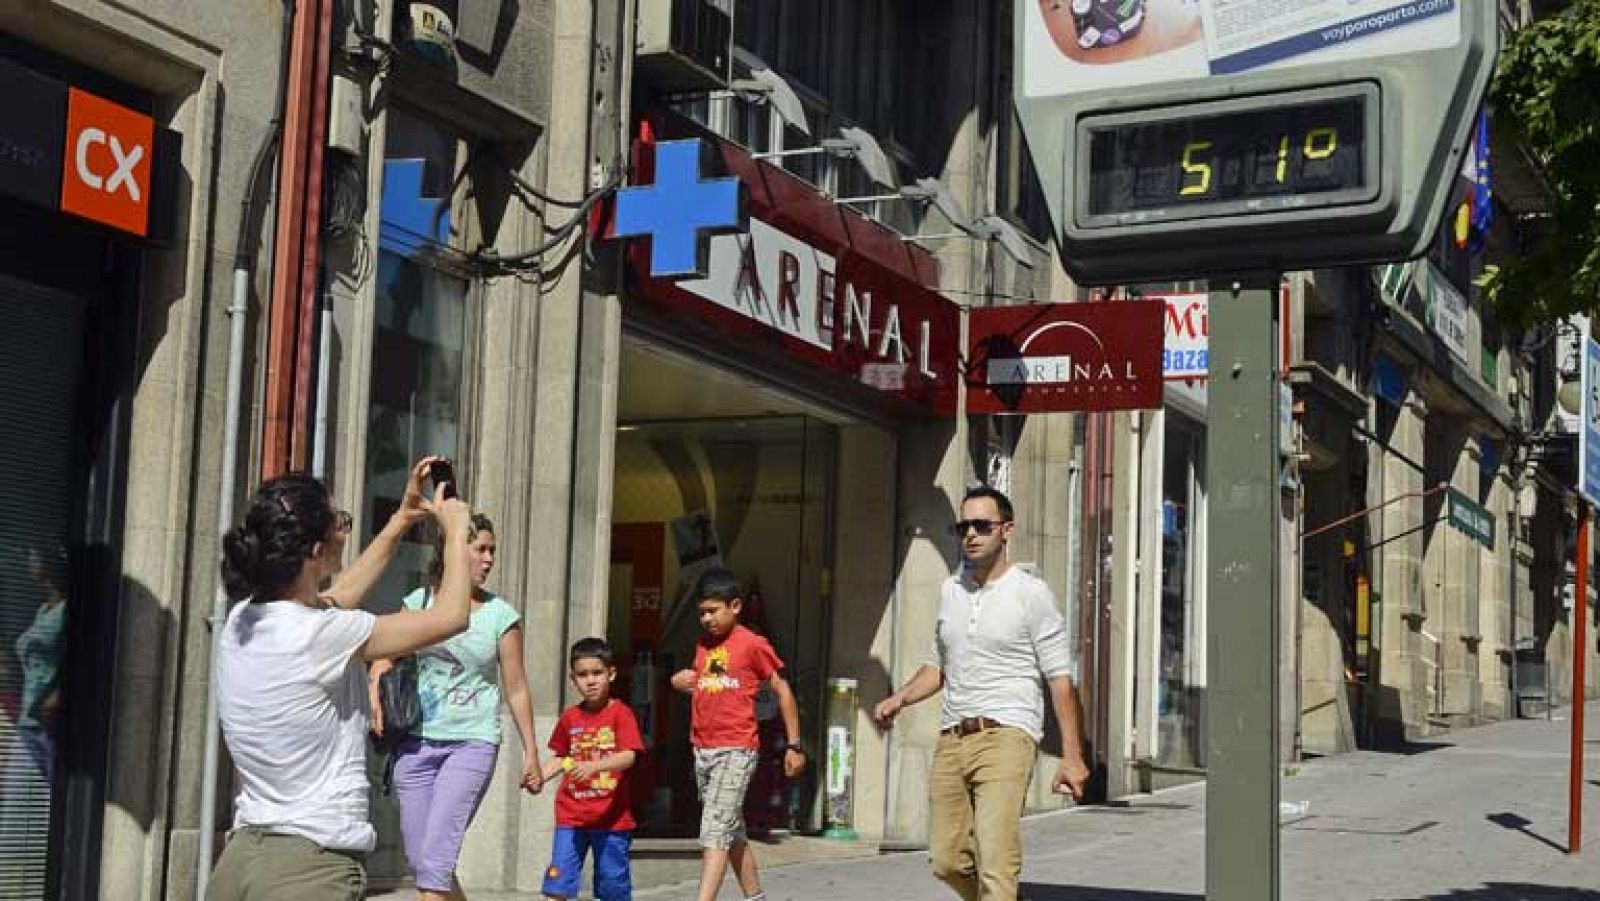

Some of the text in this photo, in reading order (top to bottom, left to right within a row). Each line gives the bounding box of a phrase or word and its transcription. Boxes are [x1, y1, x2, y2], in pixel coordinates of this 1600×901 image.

[77, 128, 144, 201] CX
[734, 232, 937, 379] ARENAL
[1012, 361, 1138, 382] ARENAL
